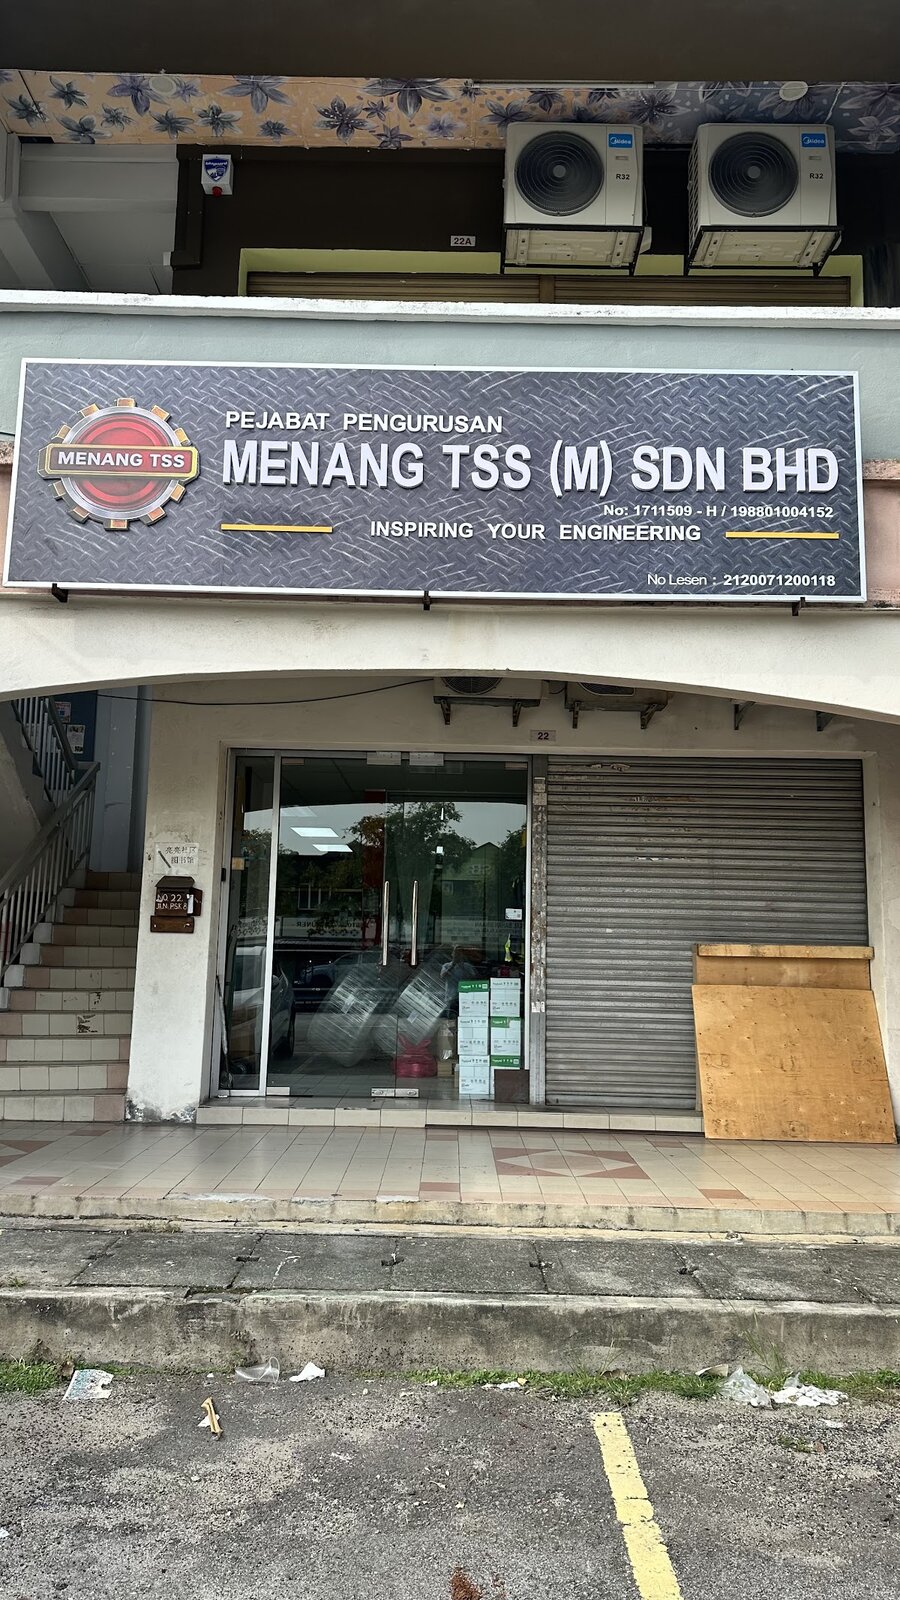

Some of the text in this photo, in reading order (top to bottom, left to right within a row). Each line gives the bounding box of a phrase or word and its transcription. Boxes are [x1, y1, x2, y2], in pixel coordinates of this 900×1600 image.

[615, 173, 631, 181] R32
[809, 172, 824, 180] R32
[453, 237, 472, 246] 22A
[225, 411, 503, 433] PEJABAT PENGURUSAN
[57, 451, 185, 468] MENANG TSS
[222, 439, 839, 498] MENANG TSS (M) SDN BHD
[603, 504, 629, 517] No:
[634, 504, 693, 518] 1711509
[706, 506, 717, 517] H
[730, 506, 834, 518] 198801004152
[370, 520, 701, 542] INSPIRING YOUR ENGINEERING
[647, 574, 667, 586] No
[669, 574, 708, 586] Lesen
[723, 574, 836, 587] 2120071200118
[537, 731, 549, 741] 22
[156, 902, 168, 910] JLN
